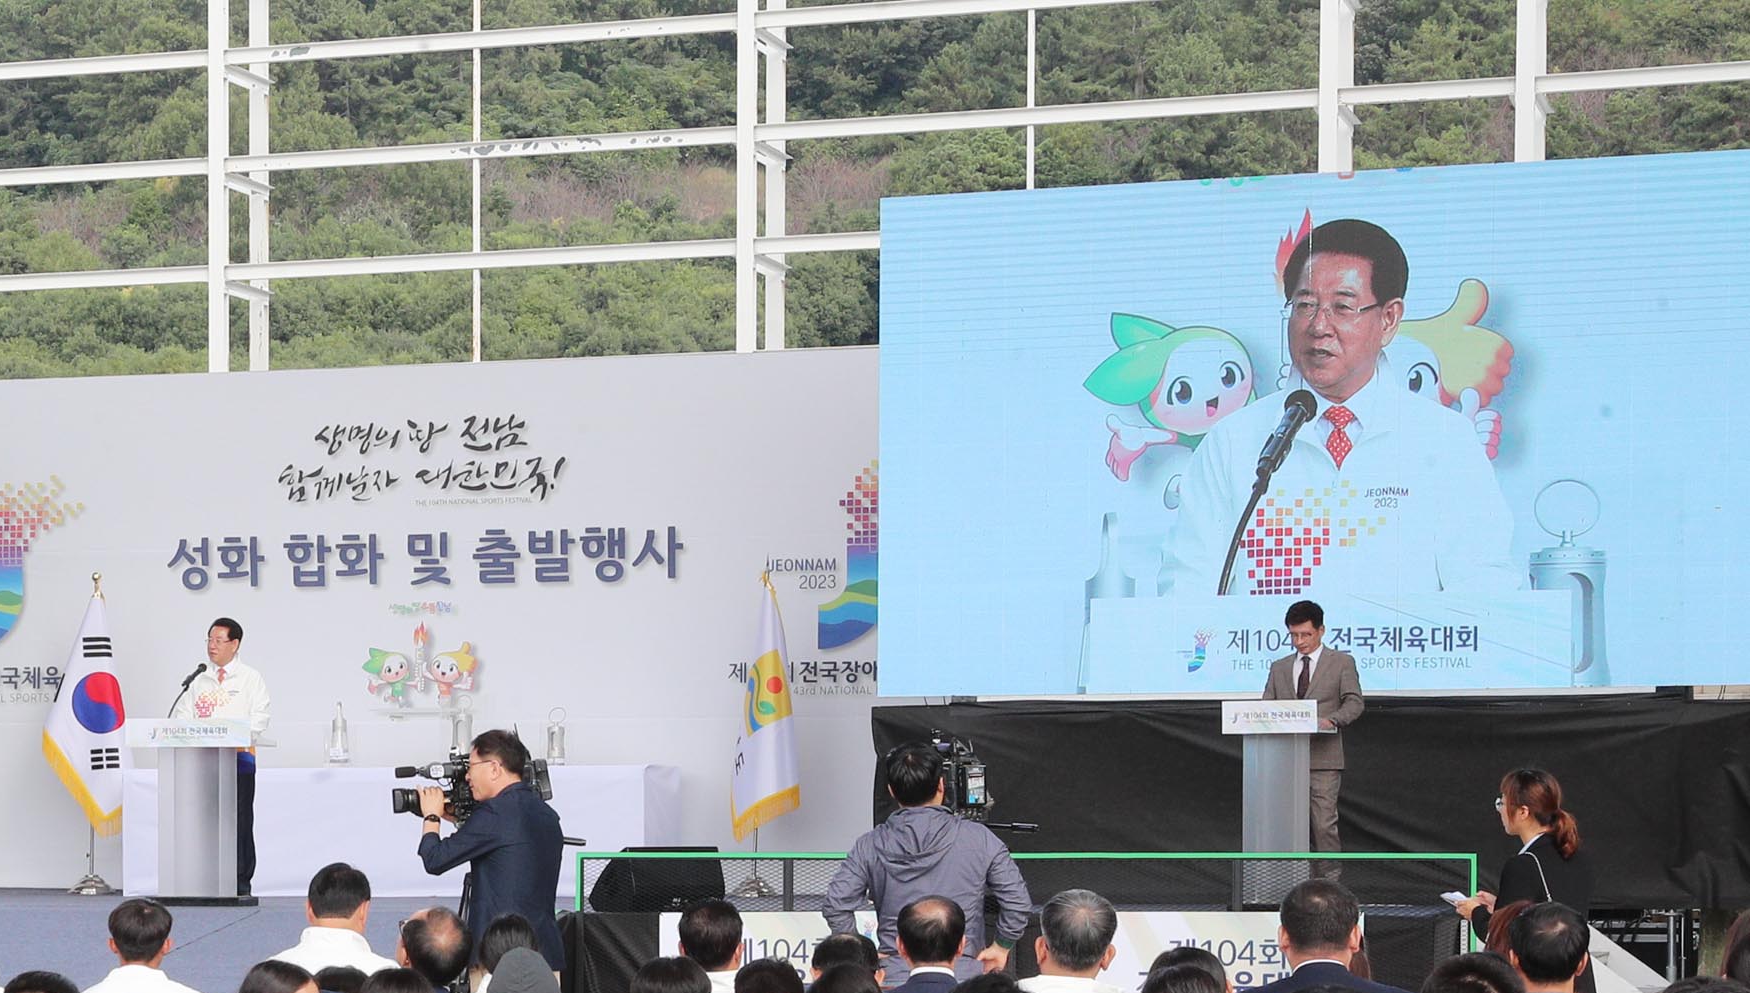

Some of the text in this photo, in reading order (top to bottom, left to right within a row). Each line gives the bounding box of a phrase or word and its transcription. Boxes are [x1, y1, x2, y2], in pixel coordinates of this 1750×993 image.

[314, 414, 529, 455] 생명의 땅 전남
[415, 456, 567, 501] 대한민국!
[1363, 487, 1409, 498] JEONNAM
[1374, 497, 1398, 509] 2023
[167, 526, 685, 591] 성화 합화 및 출발행사
[768, 558, 837, 572] JEONNAM
[799, 575, 837, 590] 2023
[1329, 625, 1479, 654] 전국체육대회
[1232, 659, 1255, 671] THE
[1360, 656, 1472, 670] SPORTS FESTIVAL
[819, 685, 872, 696] NATIONAL
[10, 693, 50, 703] SPORTS
